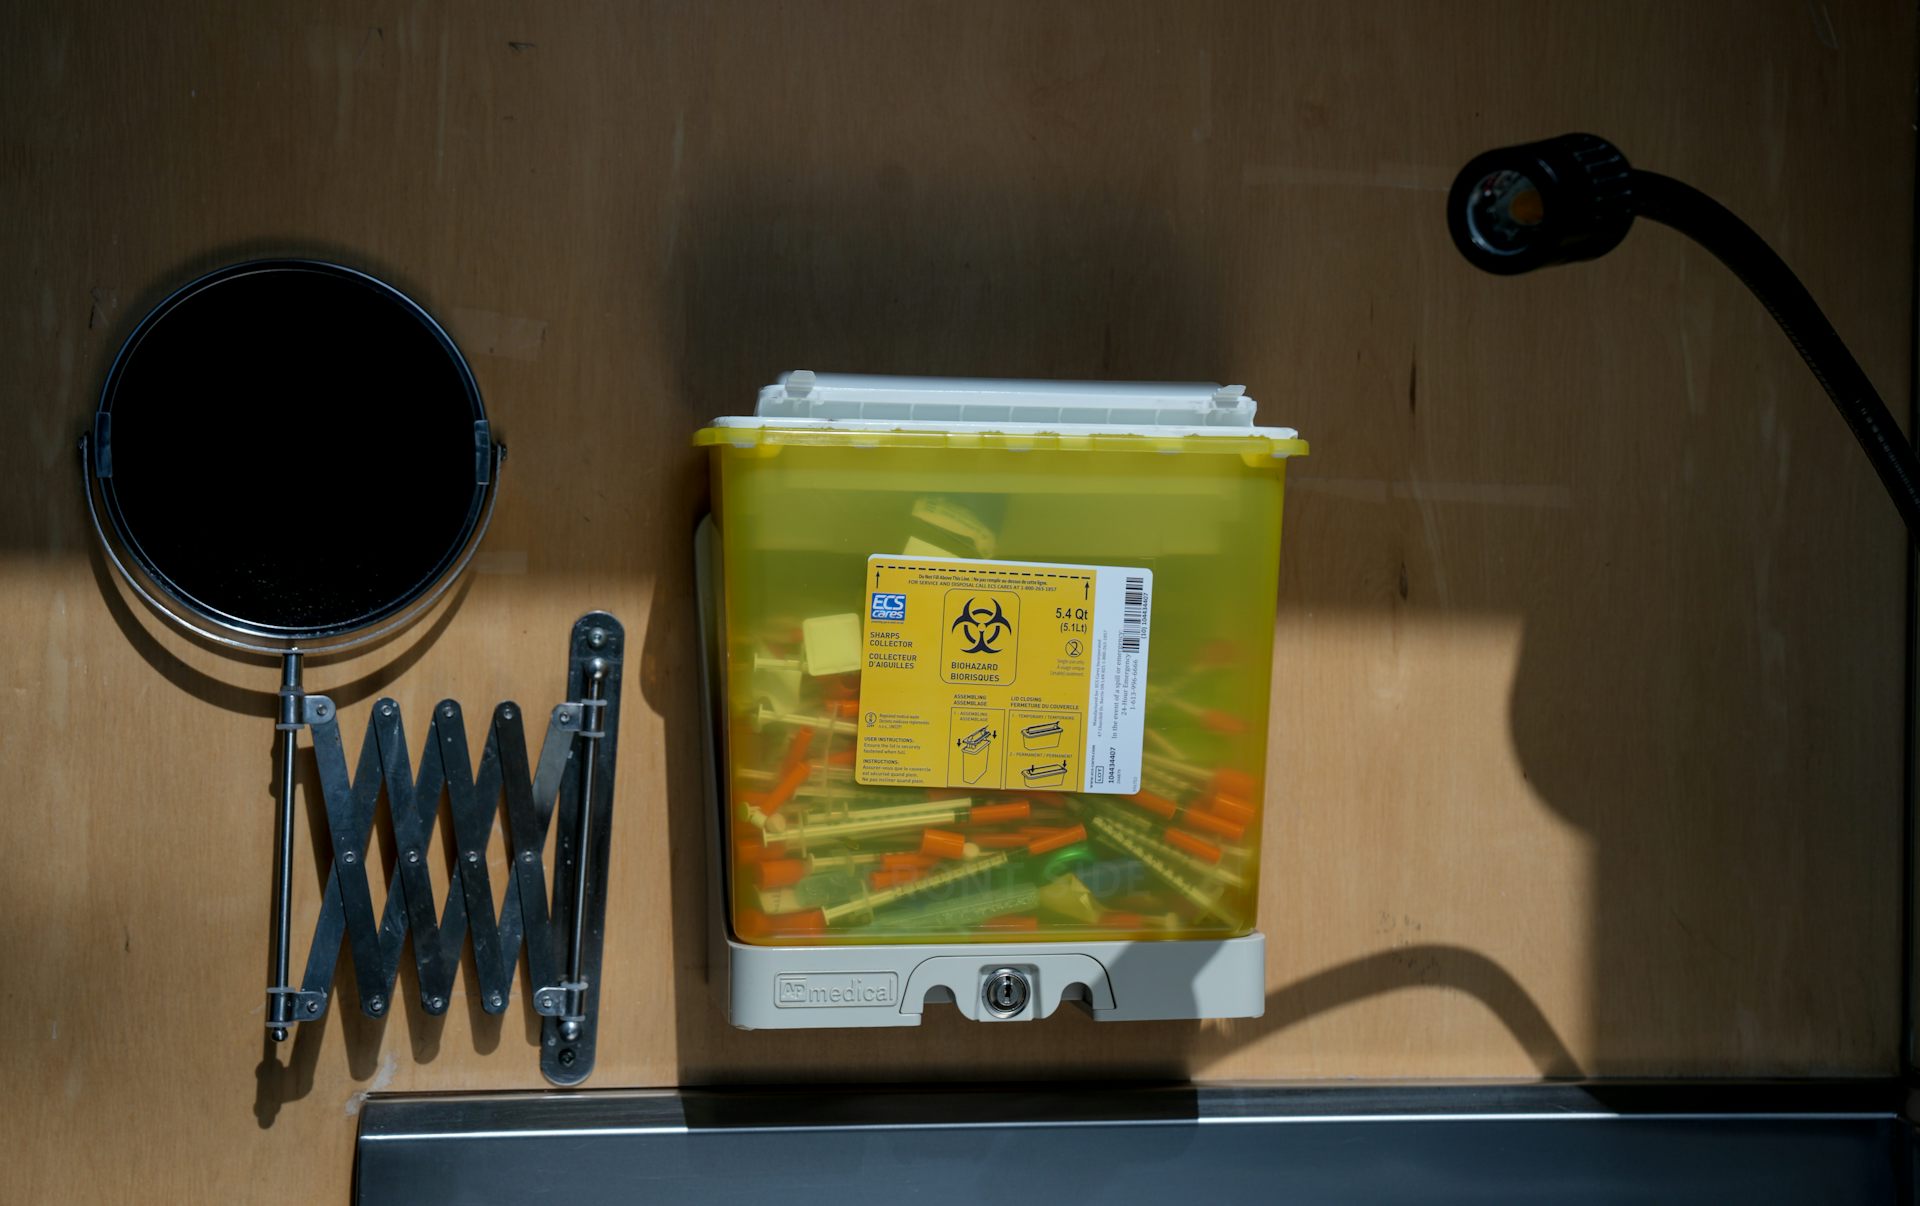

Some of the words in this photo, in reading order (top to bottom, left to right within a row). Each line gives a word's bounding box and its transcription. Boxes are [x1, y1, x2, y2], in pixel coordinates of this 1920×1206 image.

[872, 594, 905, 611] ECS
[871, 610, 904, 619] cares
[1056, 608, 1072, 619] 5.4
[1075, 608, 1088, 620] Qt
[1060, 622, 1088, 634] (5.1Lt)
[870, 632, 900, 640] SHARPS
[870, 640, 913, 648] COLLECTOR
[868, 653, 917, 662] COLLECTEUR
[868, 662, 914, 670] D'AIGUILLES
[951, 661, 999, 671] BIOHAZARD
[1123, 654, 1131, 688] Emergency
[950, 672, 1000, 682] BIORISQUES
[1108, 747, 1116, 784] 104434407
[809, 978, 893, 1003] medical
